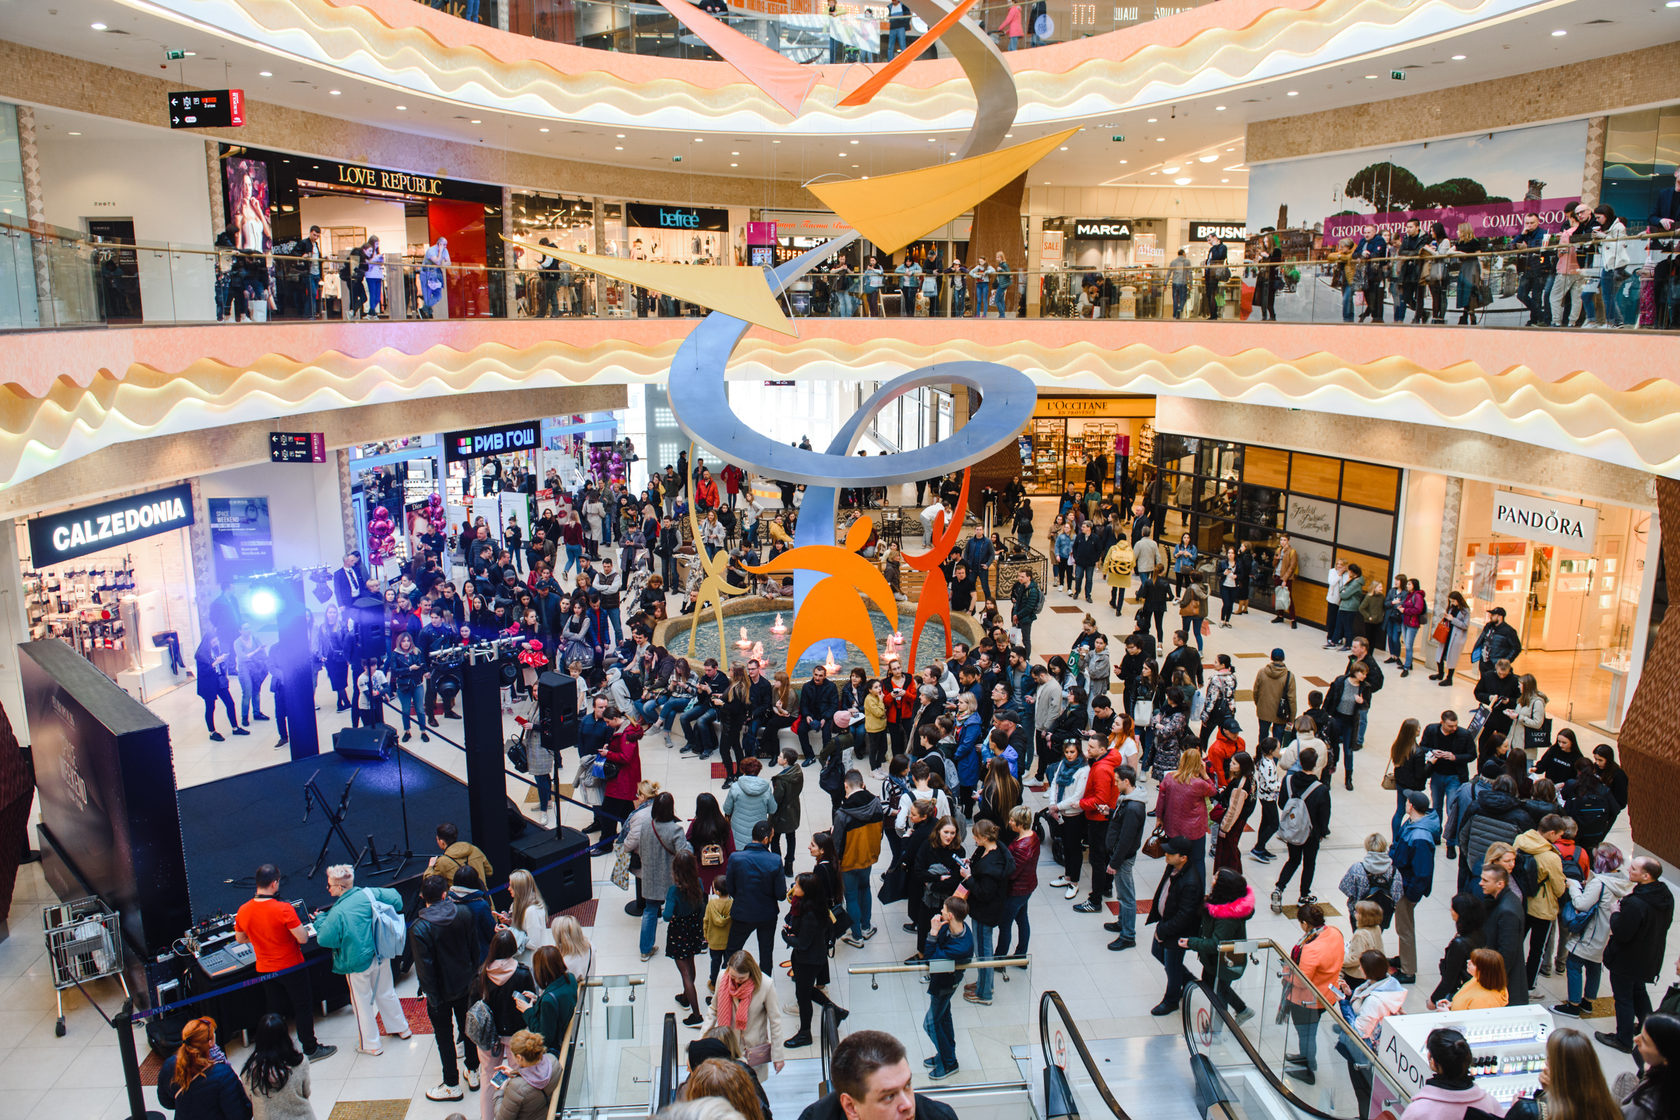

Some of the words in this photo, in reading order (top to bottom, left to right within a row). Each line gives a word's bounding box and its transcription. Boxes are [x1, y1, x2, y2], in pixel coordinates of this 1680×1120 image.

[338, 165, 376, 186] LOVE
[381, 172, 442, 195] REPUBLIC
[660, 208, 699, 228] befree
[1482, 214, 1523, 228] COMIN
[1538, 210, 1566, 225] SOO
[1077, 225, 1129, 235] MARCA
[1044, 241, 1059, 251] SALE
[1048, 402, 1107, 410] L'OCCITANE
[474, 433, 504, 453] РИВ
[506, 429, 534, 448] ГОШ
[53, 498, 186, 551] CALZEDONIA
[1497, 505, 1583, 538] PANDORA
